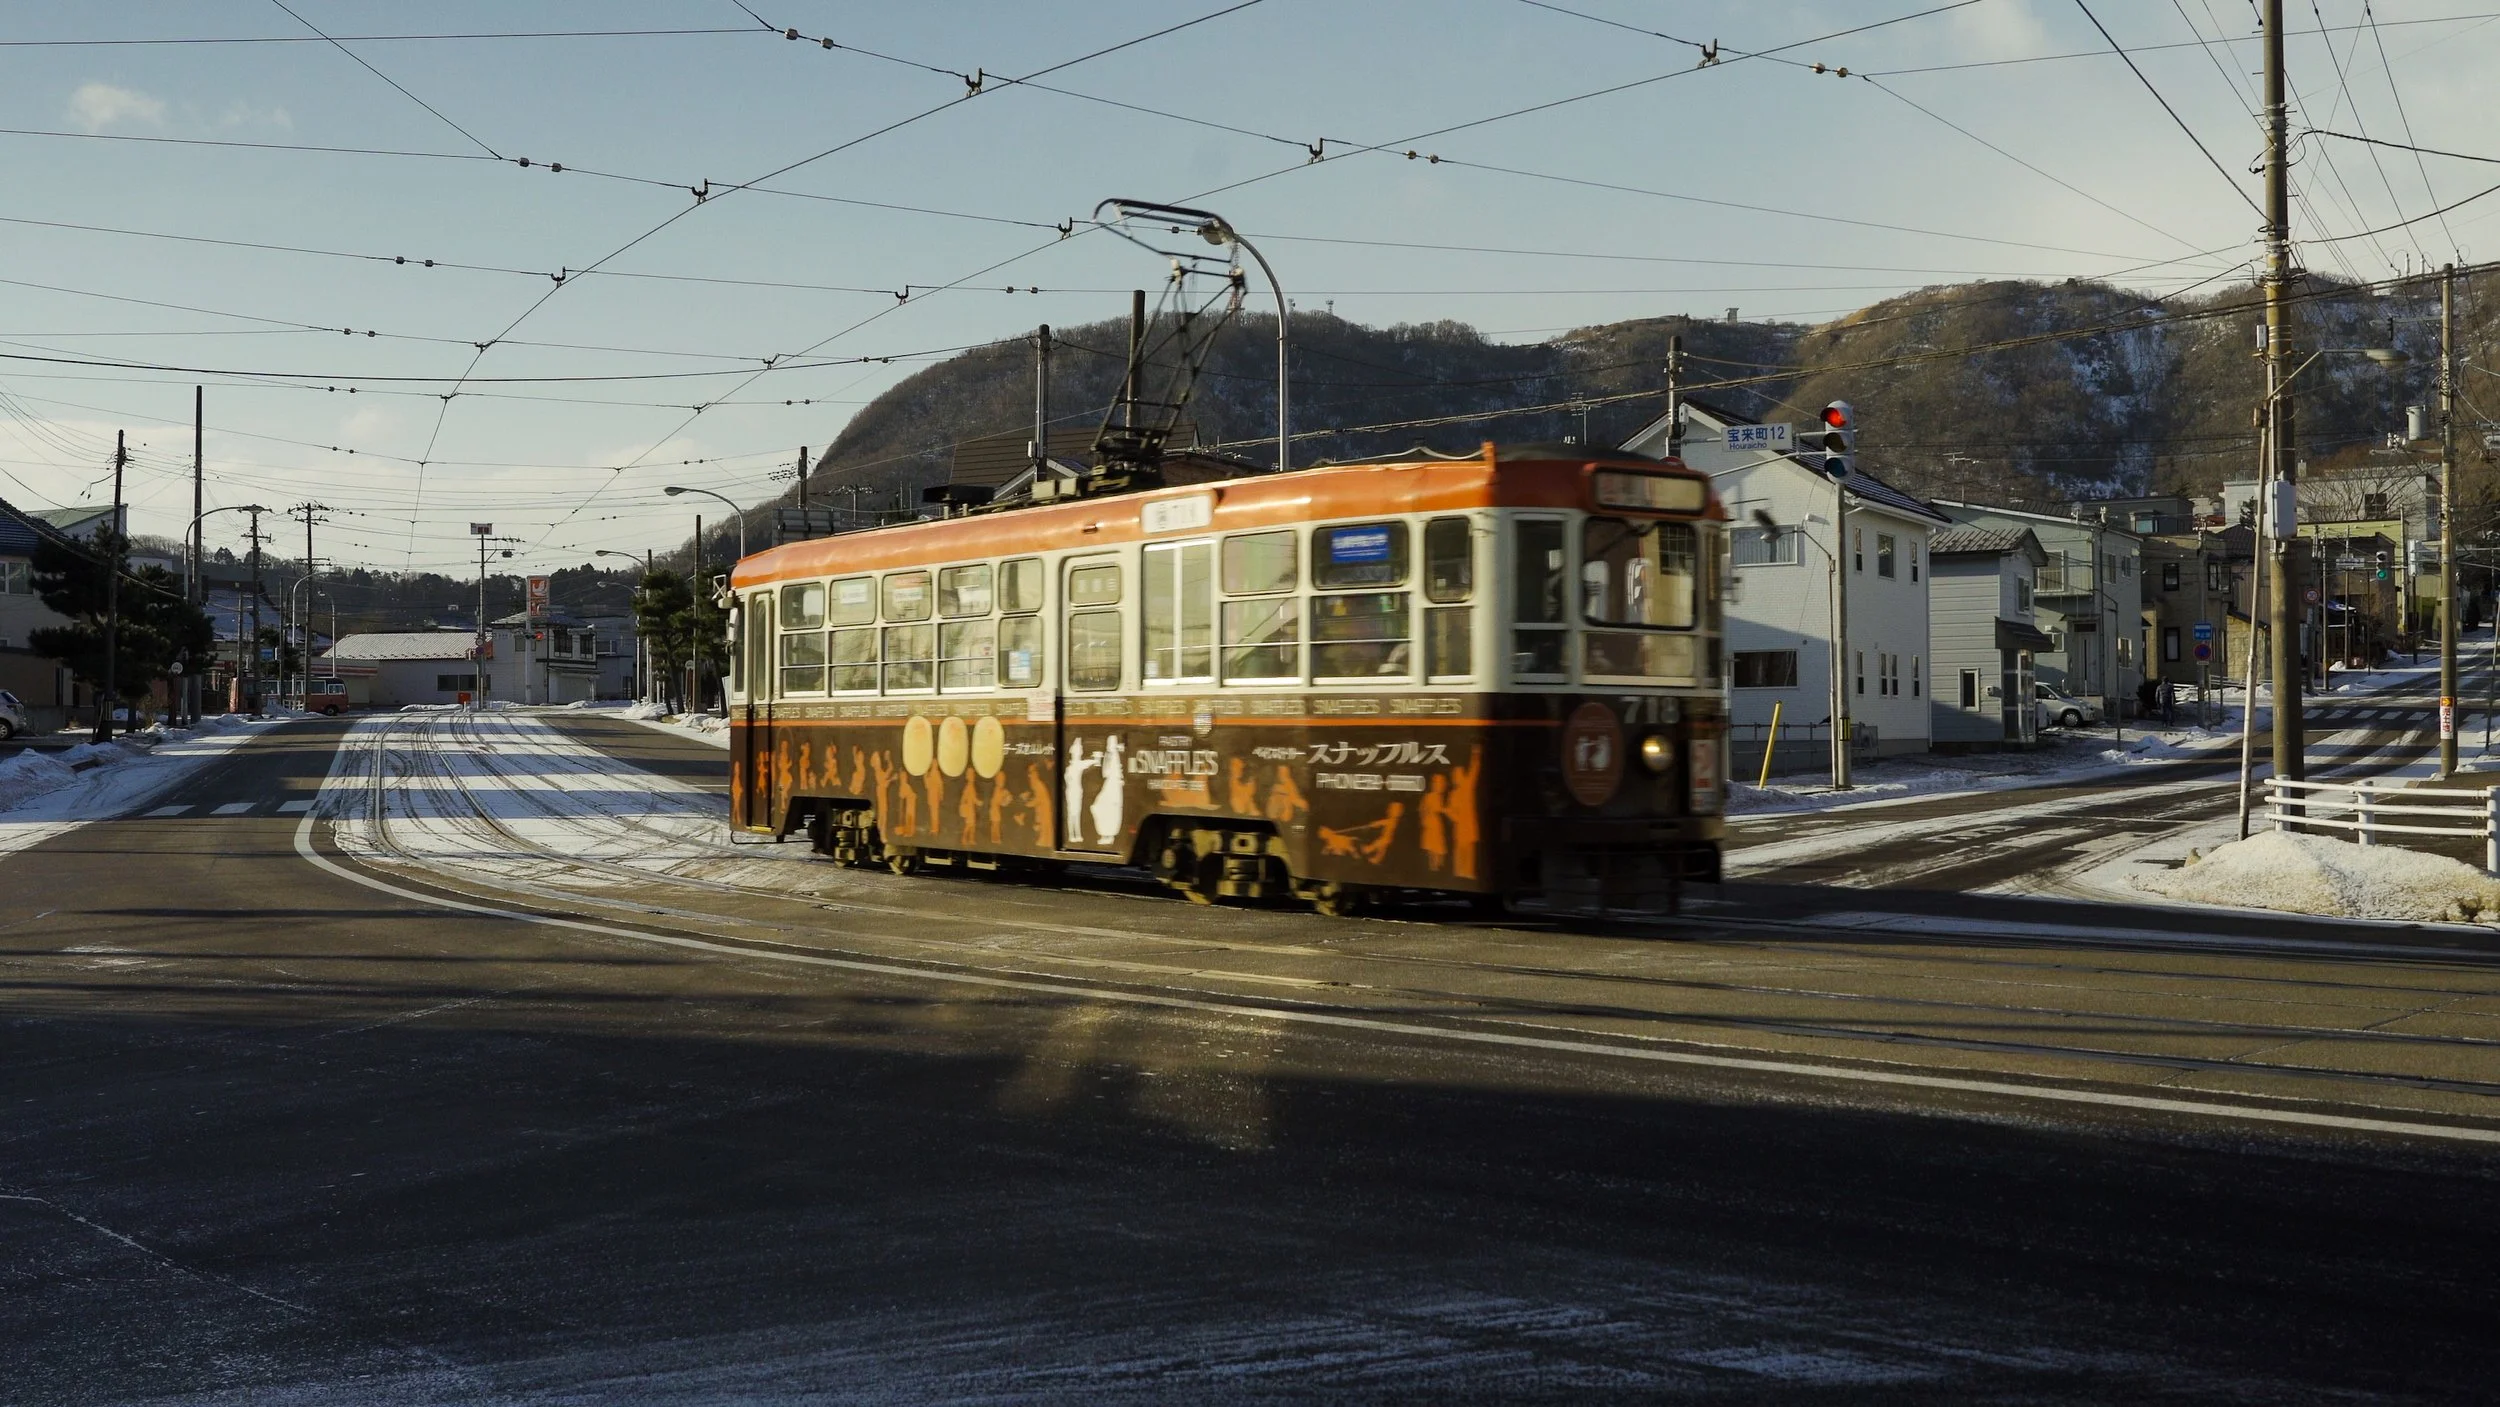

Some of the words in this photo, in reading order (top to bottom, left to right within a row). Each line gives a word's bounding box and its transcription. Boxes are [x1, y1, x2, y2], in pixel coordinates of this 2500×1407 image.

[1727, 425, 1785, 443] 宝来町12
[1729, 441, 1768, 450] Houraicho
[1619, 695, 1681, 724] 718
[1307, 741, 1452, 766] スナッフルス
